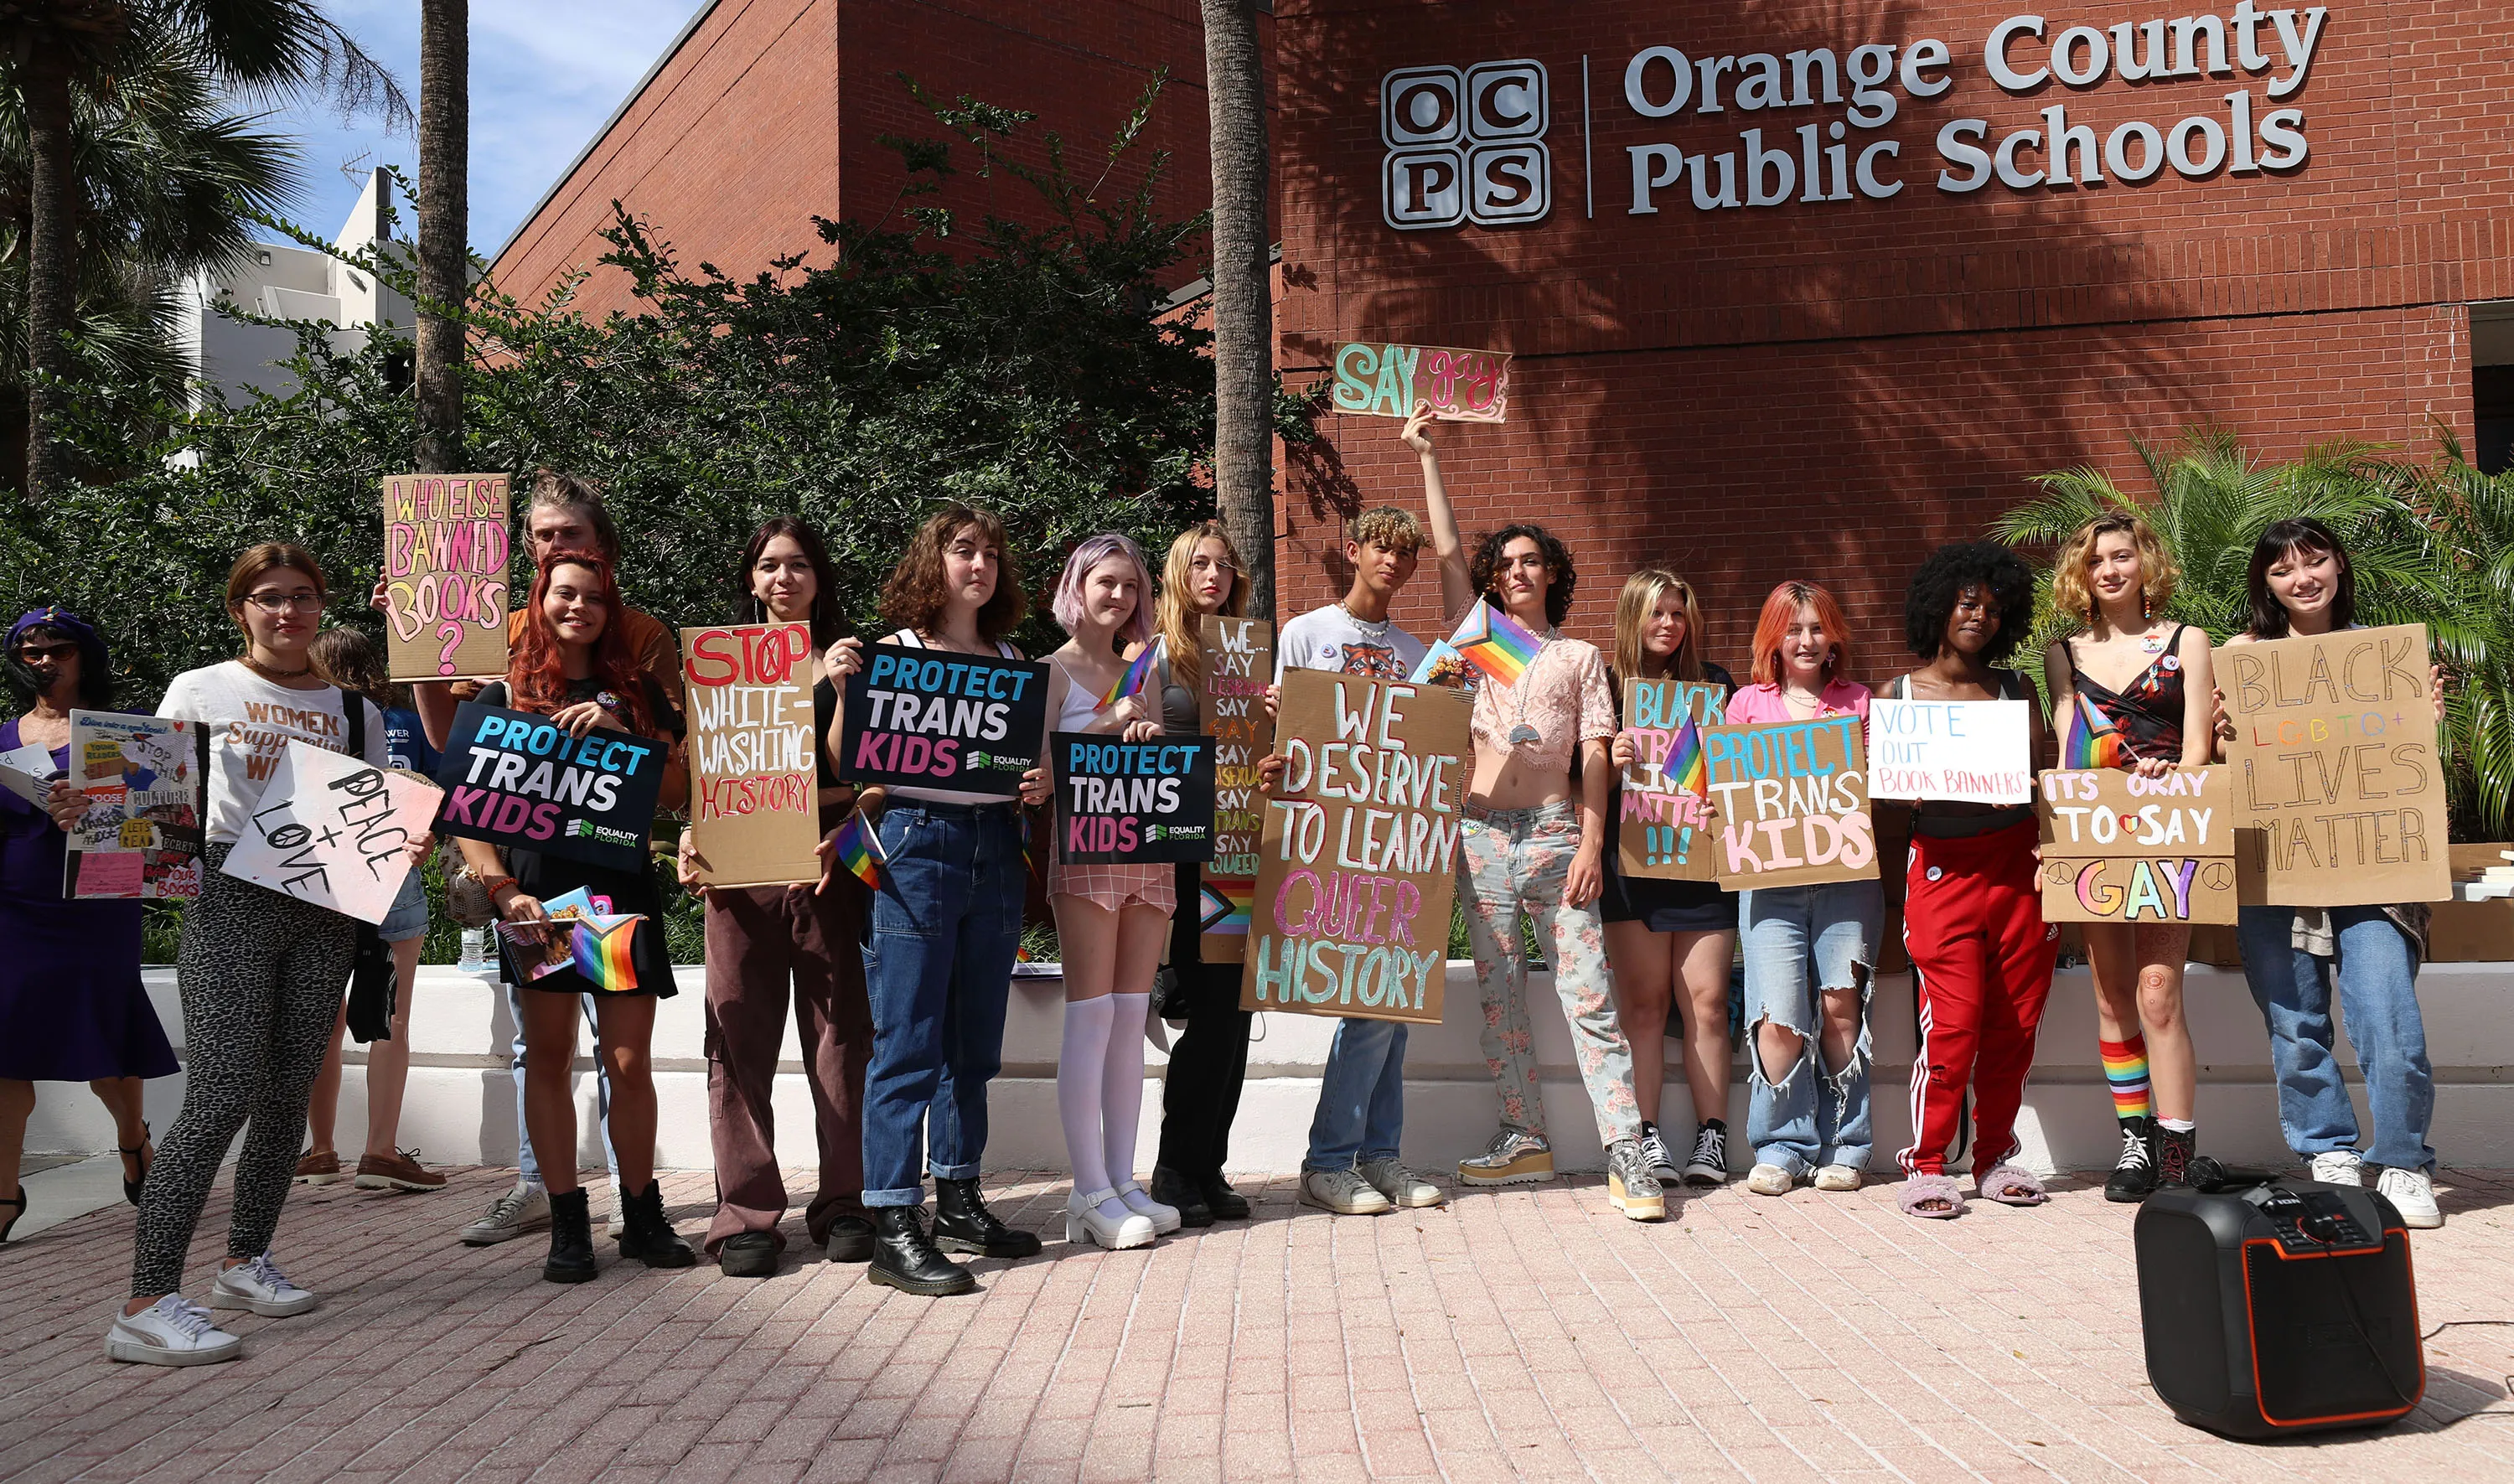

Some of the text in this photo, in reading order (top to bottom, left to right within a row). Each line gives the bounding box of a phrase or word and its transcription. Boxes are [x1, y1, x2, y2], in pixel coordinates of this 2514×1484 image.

[1624, 0, 2327, 129] Orange County
[1625, 89, 2309, 215] Public Schools
[1332, 343, 1420, 417] SAY
[393, 478, 506, 521] WHO ELSE
[391, 520, 509, 577] BANNED
[385, 574, 507, 643] BOOKS
[436, 619, 465, 676] ?
[685, 623, 812, 686] STOP
[1213, 654, 1254, 677] SAY
[869, 654, 1033, 701] PROTECT
[1208, 677, 1268, 697] LESBIAN
[2232, 636, 2422, 713] BLACK
[245, 701, 340, 737] WOMEN
[691, 684, 813, 732] WHITE-
[866, 690, 1011, 741] TRANS
[1207, 718, 1259, 742] GAY
[1216, 697, 1250, 717] SAY
[1334, 680, 1418, 751] WE
[1875, 704, 1966, 737] VOTE
[2253, 712, 2404, 747] LGBTQ+
[474, 715, 650, 776] PROTECT
[697, 724, 815, 776] WASHING
[855, 731, 960, 778] KIDS
[993, 755, 1032, 767] EQUALITY
[1069, 742, 1201, 774] PROTECT
[1215, 744, 1252, 766] SAY
[1705, 715, 1860, 784] PROTECT
[1882, 739, 1928, 764] OUT
[465, 746, 623, 812] TRANS
[699, 773, 815, 822] HISTORY
[1069, 776, 1182, 814] TRANS
[1216, 789, 1251, 809] SAY
[1283, 737, 1459, 813] DESERVE
[1708, 770, 1863, 825] TRANS
[1879, 768, 2026, 795] BOOK BANNERS
[2044, 769, 2209, 802] ITS OKAY
[2245, 742, 2428, 811] LIVES
[328, 768, 408, 882] PEACE
[442, 784, 562, 840] KIDS
[595, 825, 639, 841] EQUALITY
[1068, 815, 1139, 852] KIDS
[1169, 825, 1206, 835] EQUALITY
[1270, 797, 1461, 875] TO LEARN
[2053, 804, 2213, 846] TO SAY
[252, 799, 331, 897] LOVE
[593, 833, 637, 849] FLORIDA
[1215, 835, 1252, 853] SAY
[1722, 811, 1874, 873] KIDS
[2253, 807, 2428, 872] MATTER
[156, 880, 199, 897] BOOKS
[172, 867, 197, 882] OUR
[2075, 857, 2200, 921] GAY
[1274, 867, 1422, 947] QUEER
[1255, 934, 1440, 1011] HISTORY
